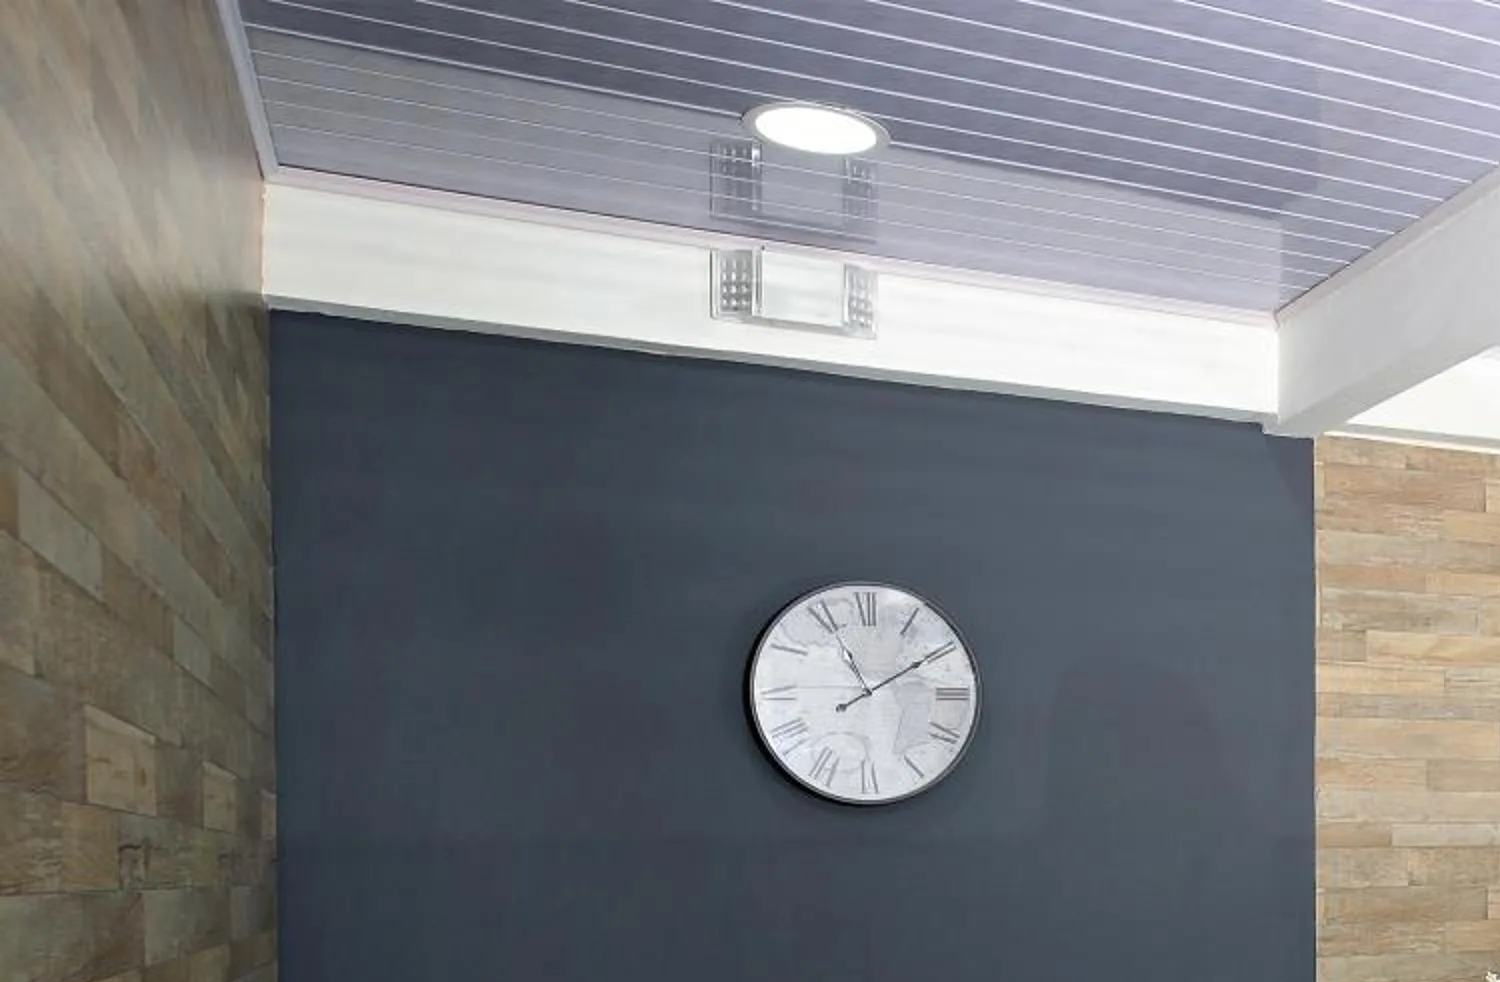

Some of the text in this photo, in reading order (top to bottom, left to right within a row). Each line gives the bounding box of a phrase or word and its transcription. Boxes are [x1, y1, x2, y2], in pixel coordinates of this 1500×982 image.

[854, 591, 877, 626] XII
[900, 607, 920, 636] I
[935, 687, 970, 701] III
